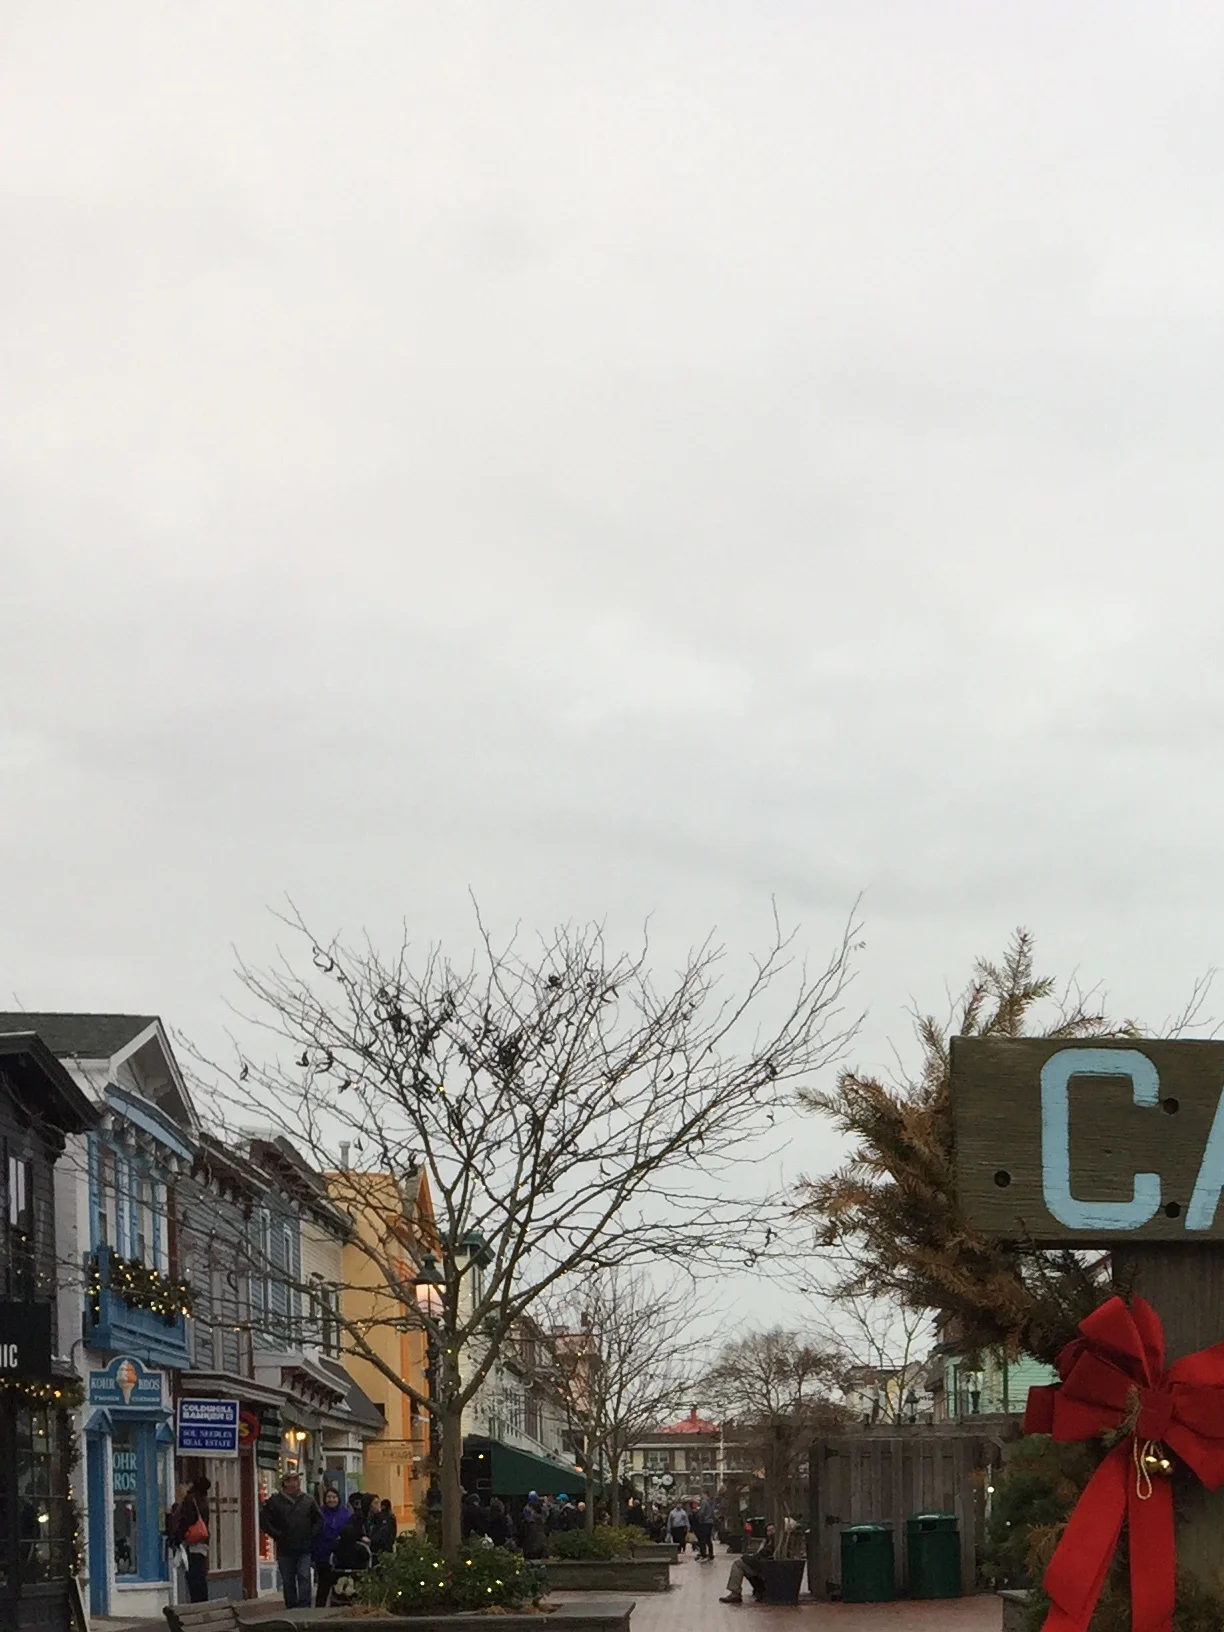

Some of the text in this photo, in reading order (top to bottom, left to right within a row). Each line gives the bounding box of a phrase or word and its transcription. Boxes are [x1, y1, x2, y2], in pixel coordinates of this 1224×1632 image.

[0, 1343, 18, 1368] IC
[182, 1404, 232, 1413] COLDWELL
[182, 1411, 224, 1420] BANKER
[113, 1451, 138, 1470] OHR
[114, 1472, 137, 1490] ROS
